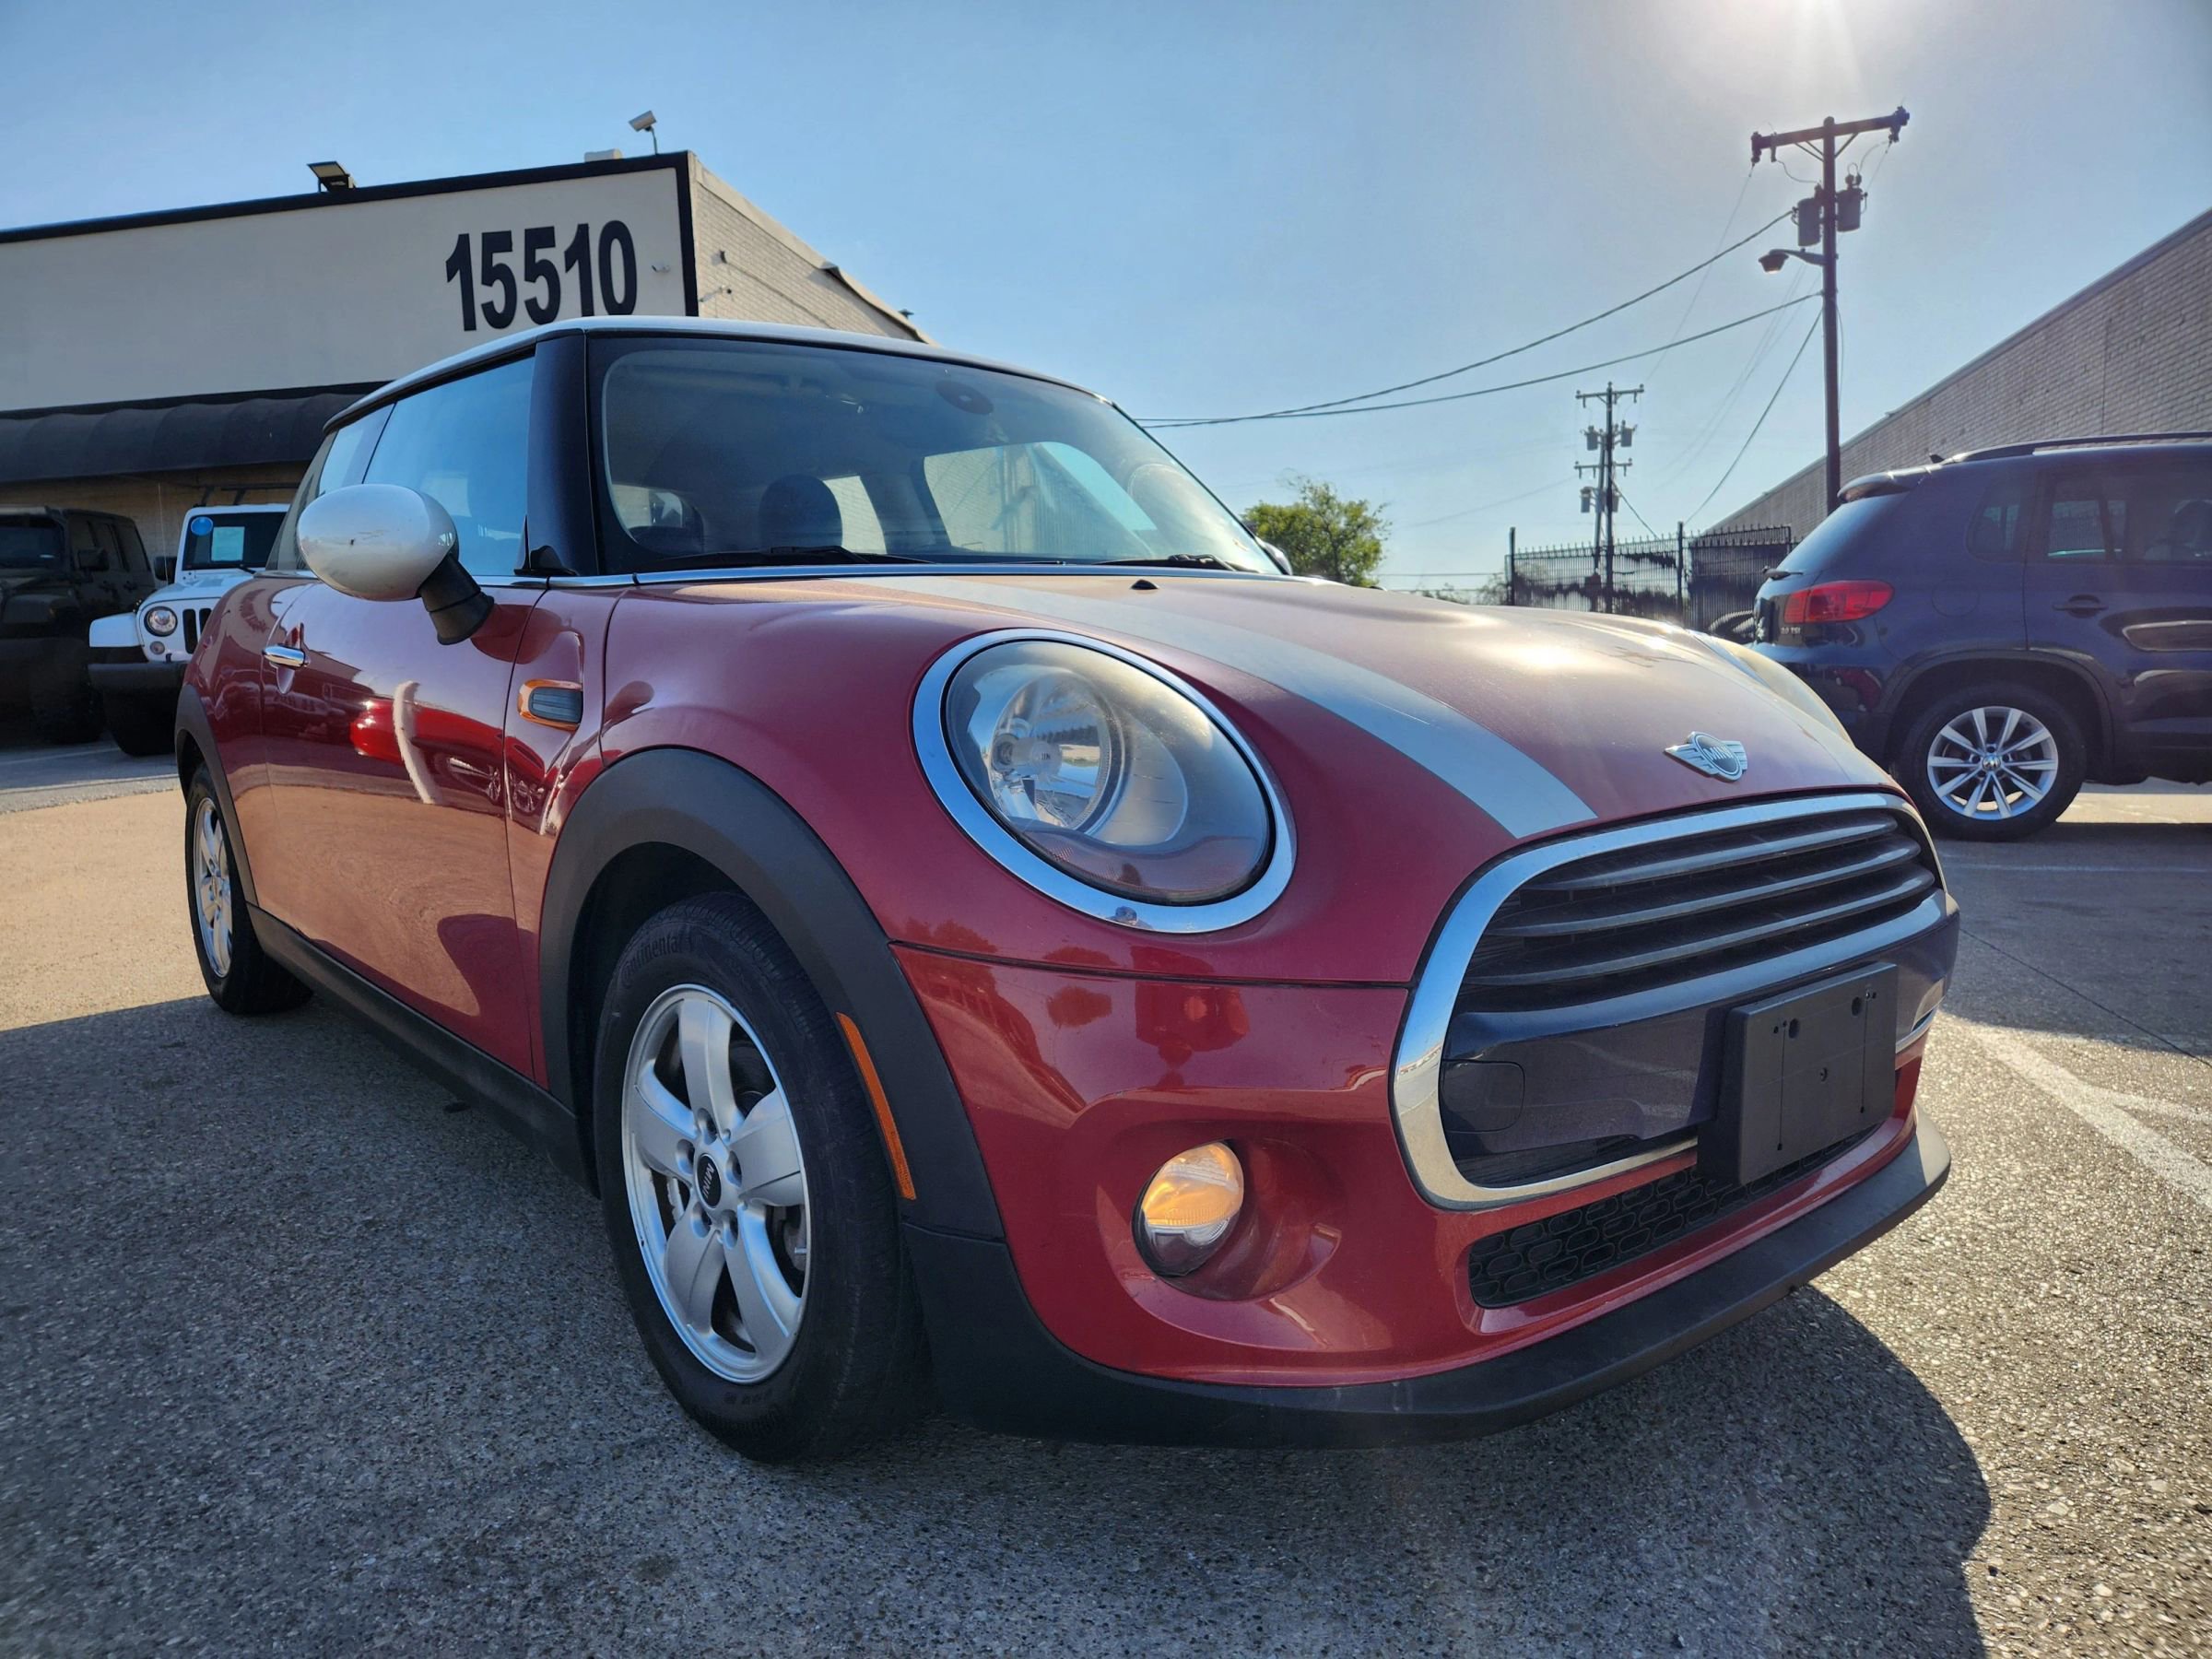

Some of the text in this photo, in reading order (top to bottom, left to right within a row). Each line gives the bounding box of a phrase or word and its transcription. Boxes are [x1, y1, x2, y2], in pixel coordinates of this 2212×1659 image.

[446, 220, 637, 331] 15510
[1703, 747, 1733, 760] MINI
[702, 1162, 715, 1198] MINI
